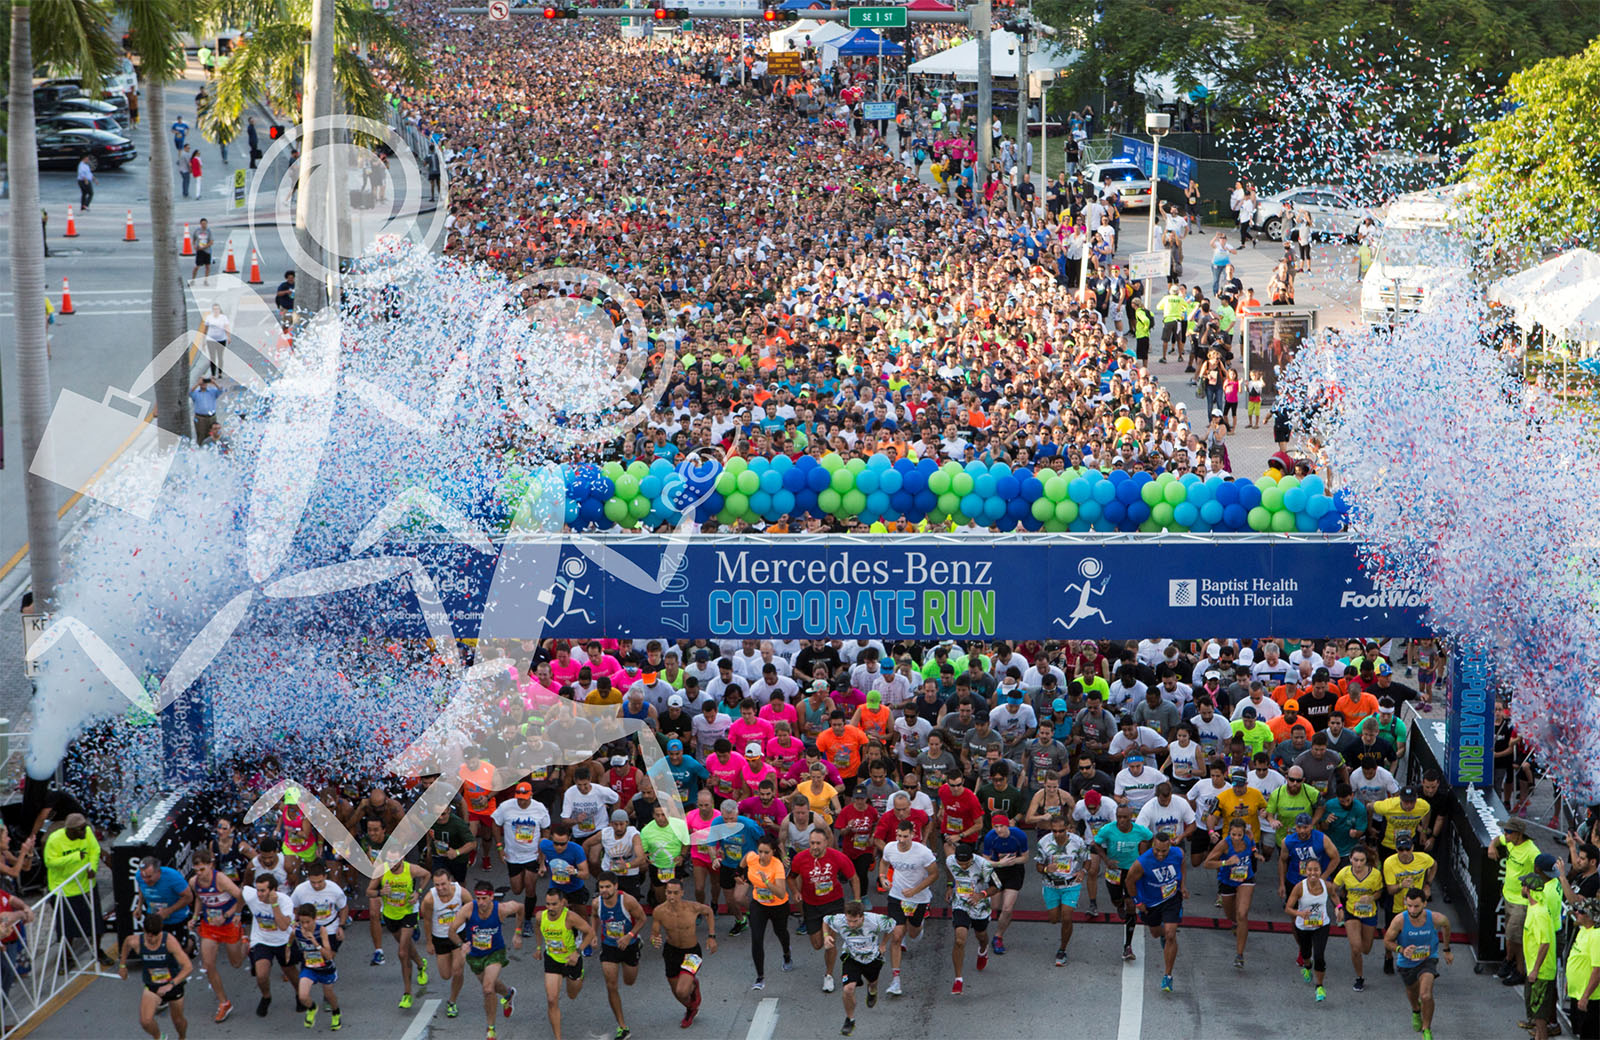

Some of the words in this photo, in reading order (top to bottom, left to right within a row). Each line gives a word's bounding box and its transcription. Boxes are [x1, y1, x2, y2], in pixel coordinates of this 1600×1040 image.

[862, 13, 872, 21] SE
[884, 13, 893, 21] ST
[715, 551, 993, 585] Mercedes-Benz
[1202, 578, 1248, 593] Baptist
[1252, 578, 1298, 591] Health
[659, 552, 690, 633] 2017
[1202, 593, 1241, 607] South
[1244, 593, 1294, 607] Florida
[708, 590, 918, 636] CORPORATE
[922, 590, 997, 636] RUN
[1458, 746, 1485, 783] RUN
[128, 857, 147, 935] STAR
